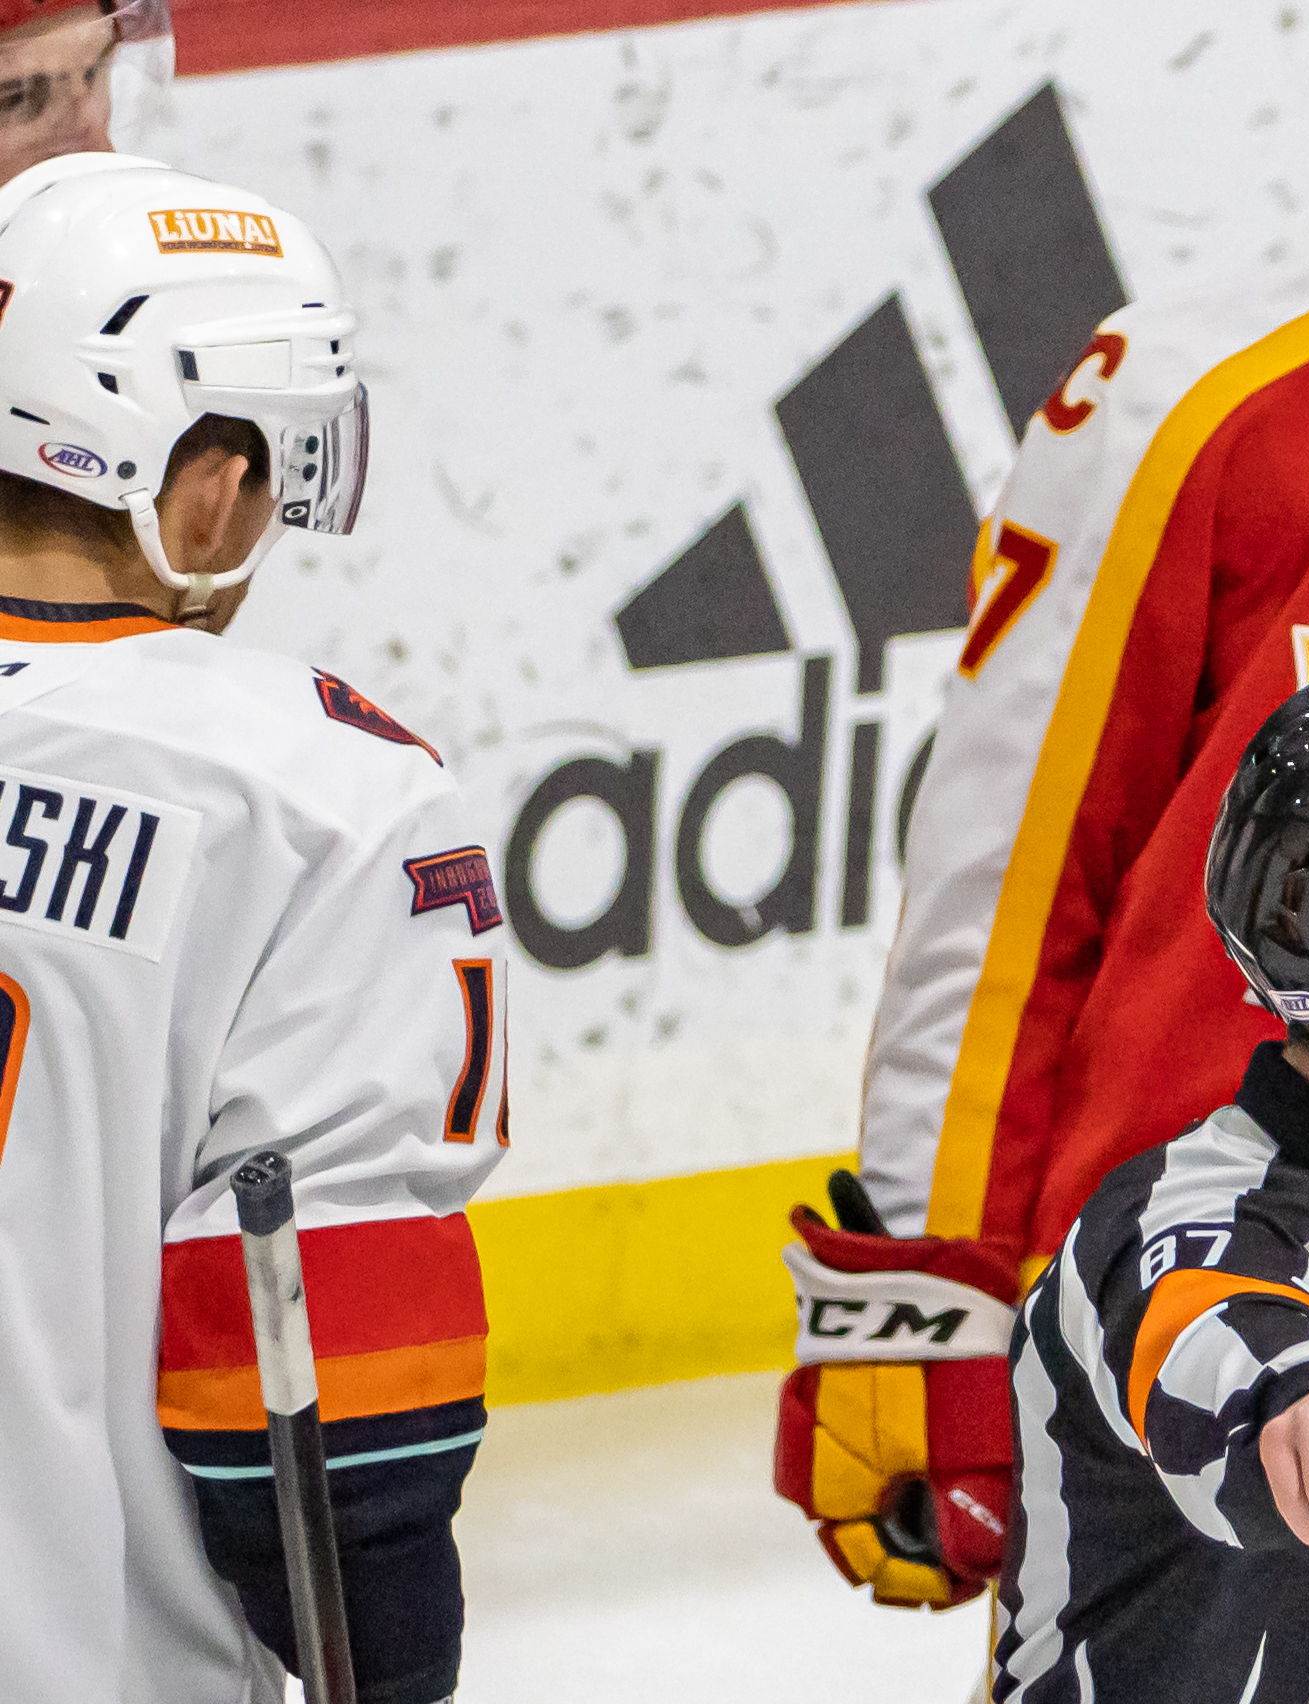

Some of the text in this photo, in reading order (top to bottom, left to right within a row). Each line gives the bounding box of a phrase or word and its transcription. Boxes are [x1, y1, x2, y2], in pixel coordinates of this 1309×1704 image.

[0, 780, 161, 940] SKI
[503, 656, 938, 971] adi
[444, 957, 509, 1148] 1
[796, 1296, 970, 1344] CM
